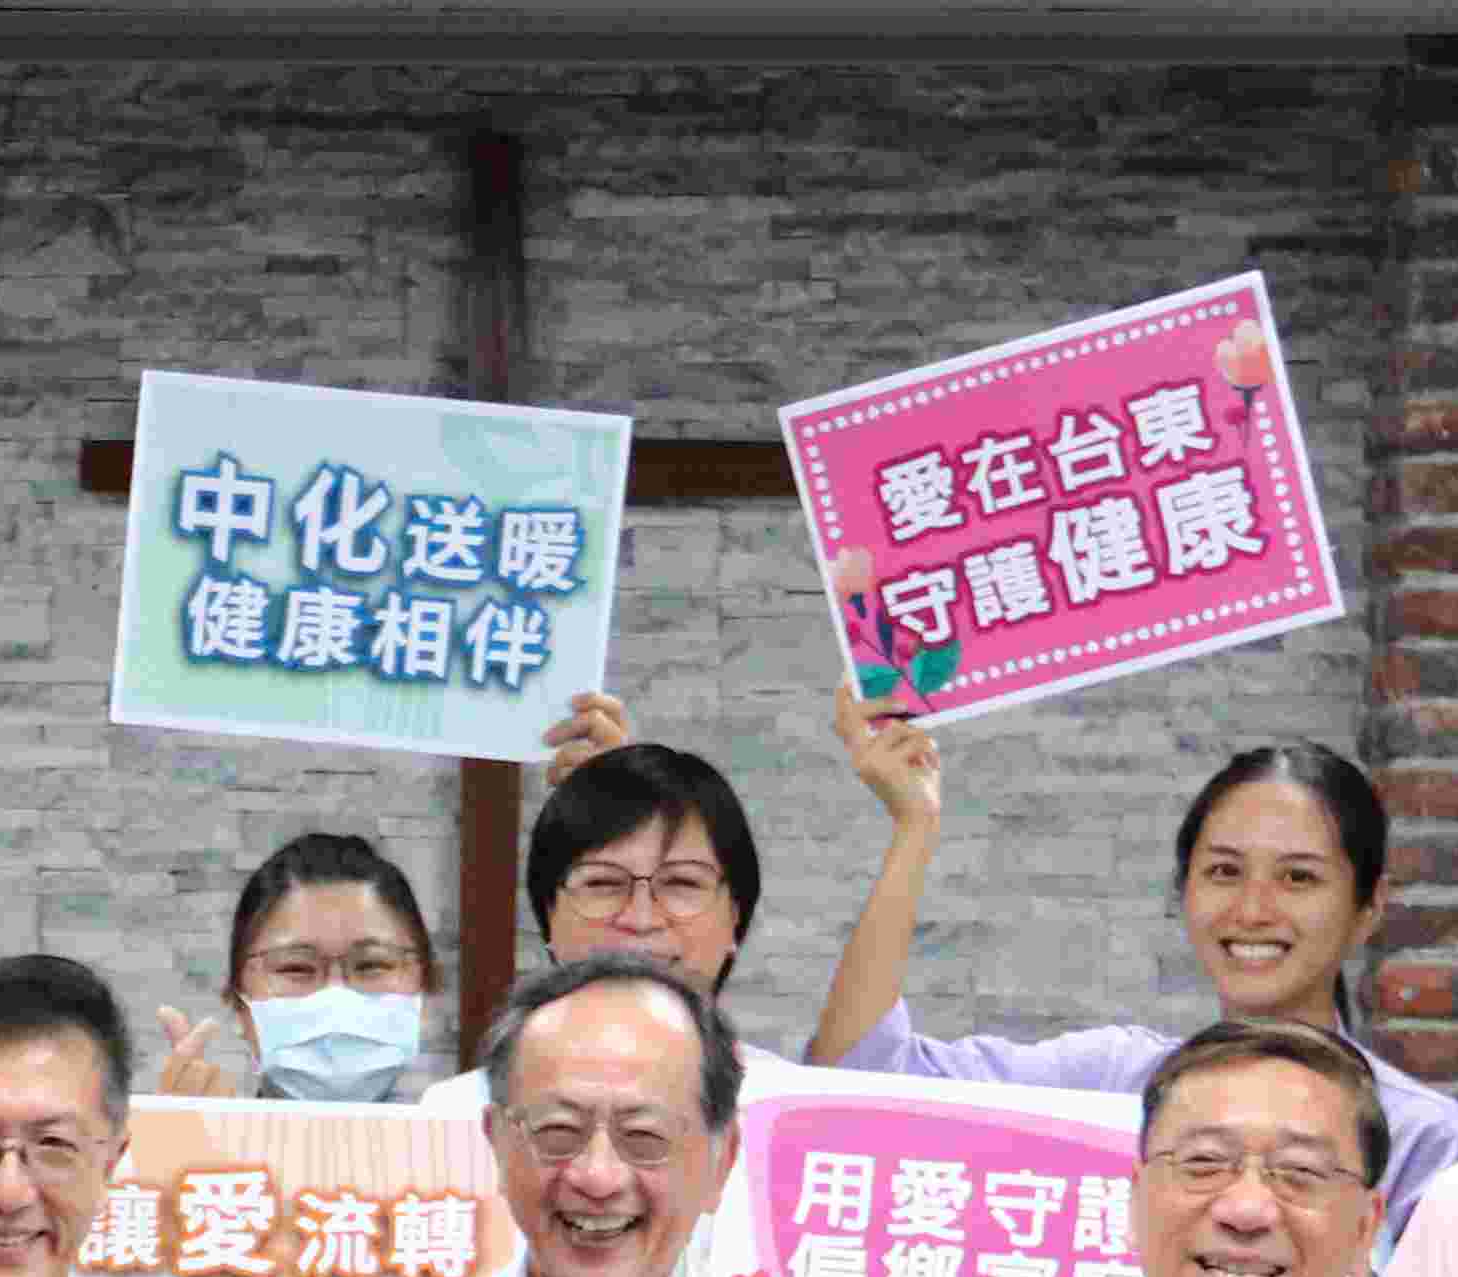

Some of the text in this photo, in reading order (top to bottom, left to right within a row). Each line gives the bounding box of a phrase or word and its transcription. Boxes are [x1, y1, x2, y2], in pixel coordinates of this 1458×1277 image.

[175, 453, 581, 594] 中化送暖
[878, 381, 1215, 544] 愛在台東
[186, 573, 550, 690] 健康相伴
[880, 466, 1266, 648] 守護健康
